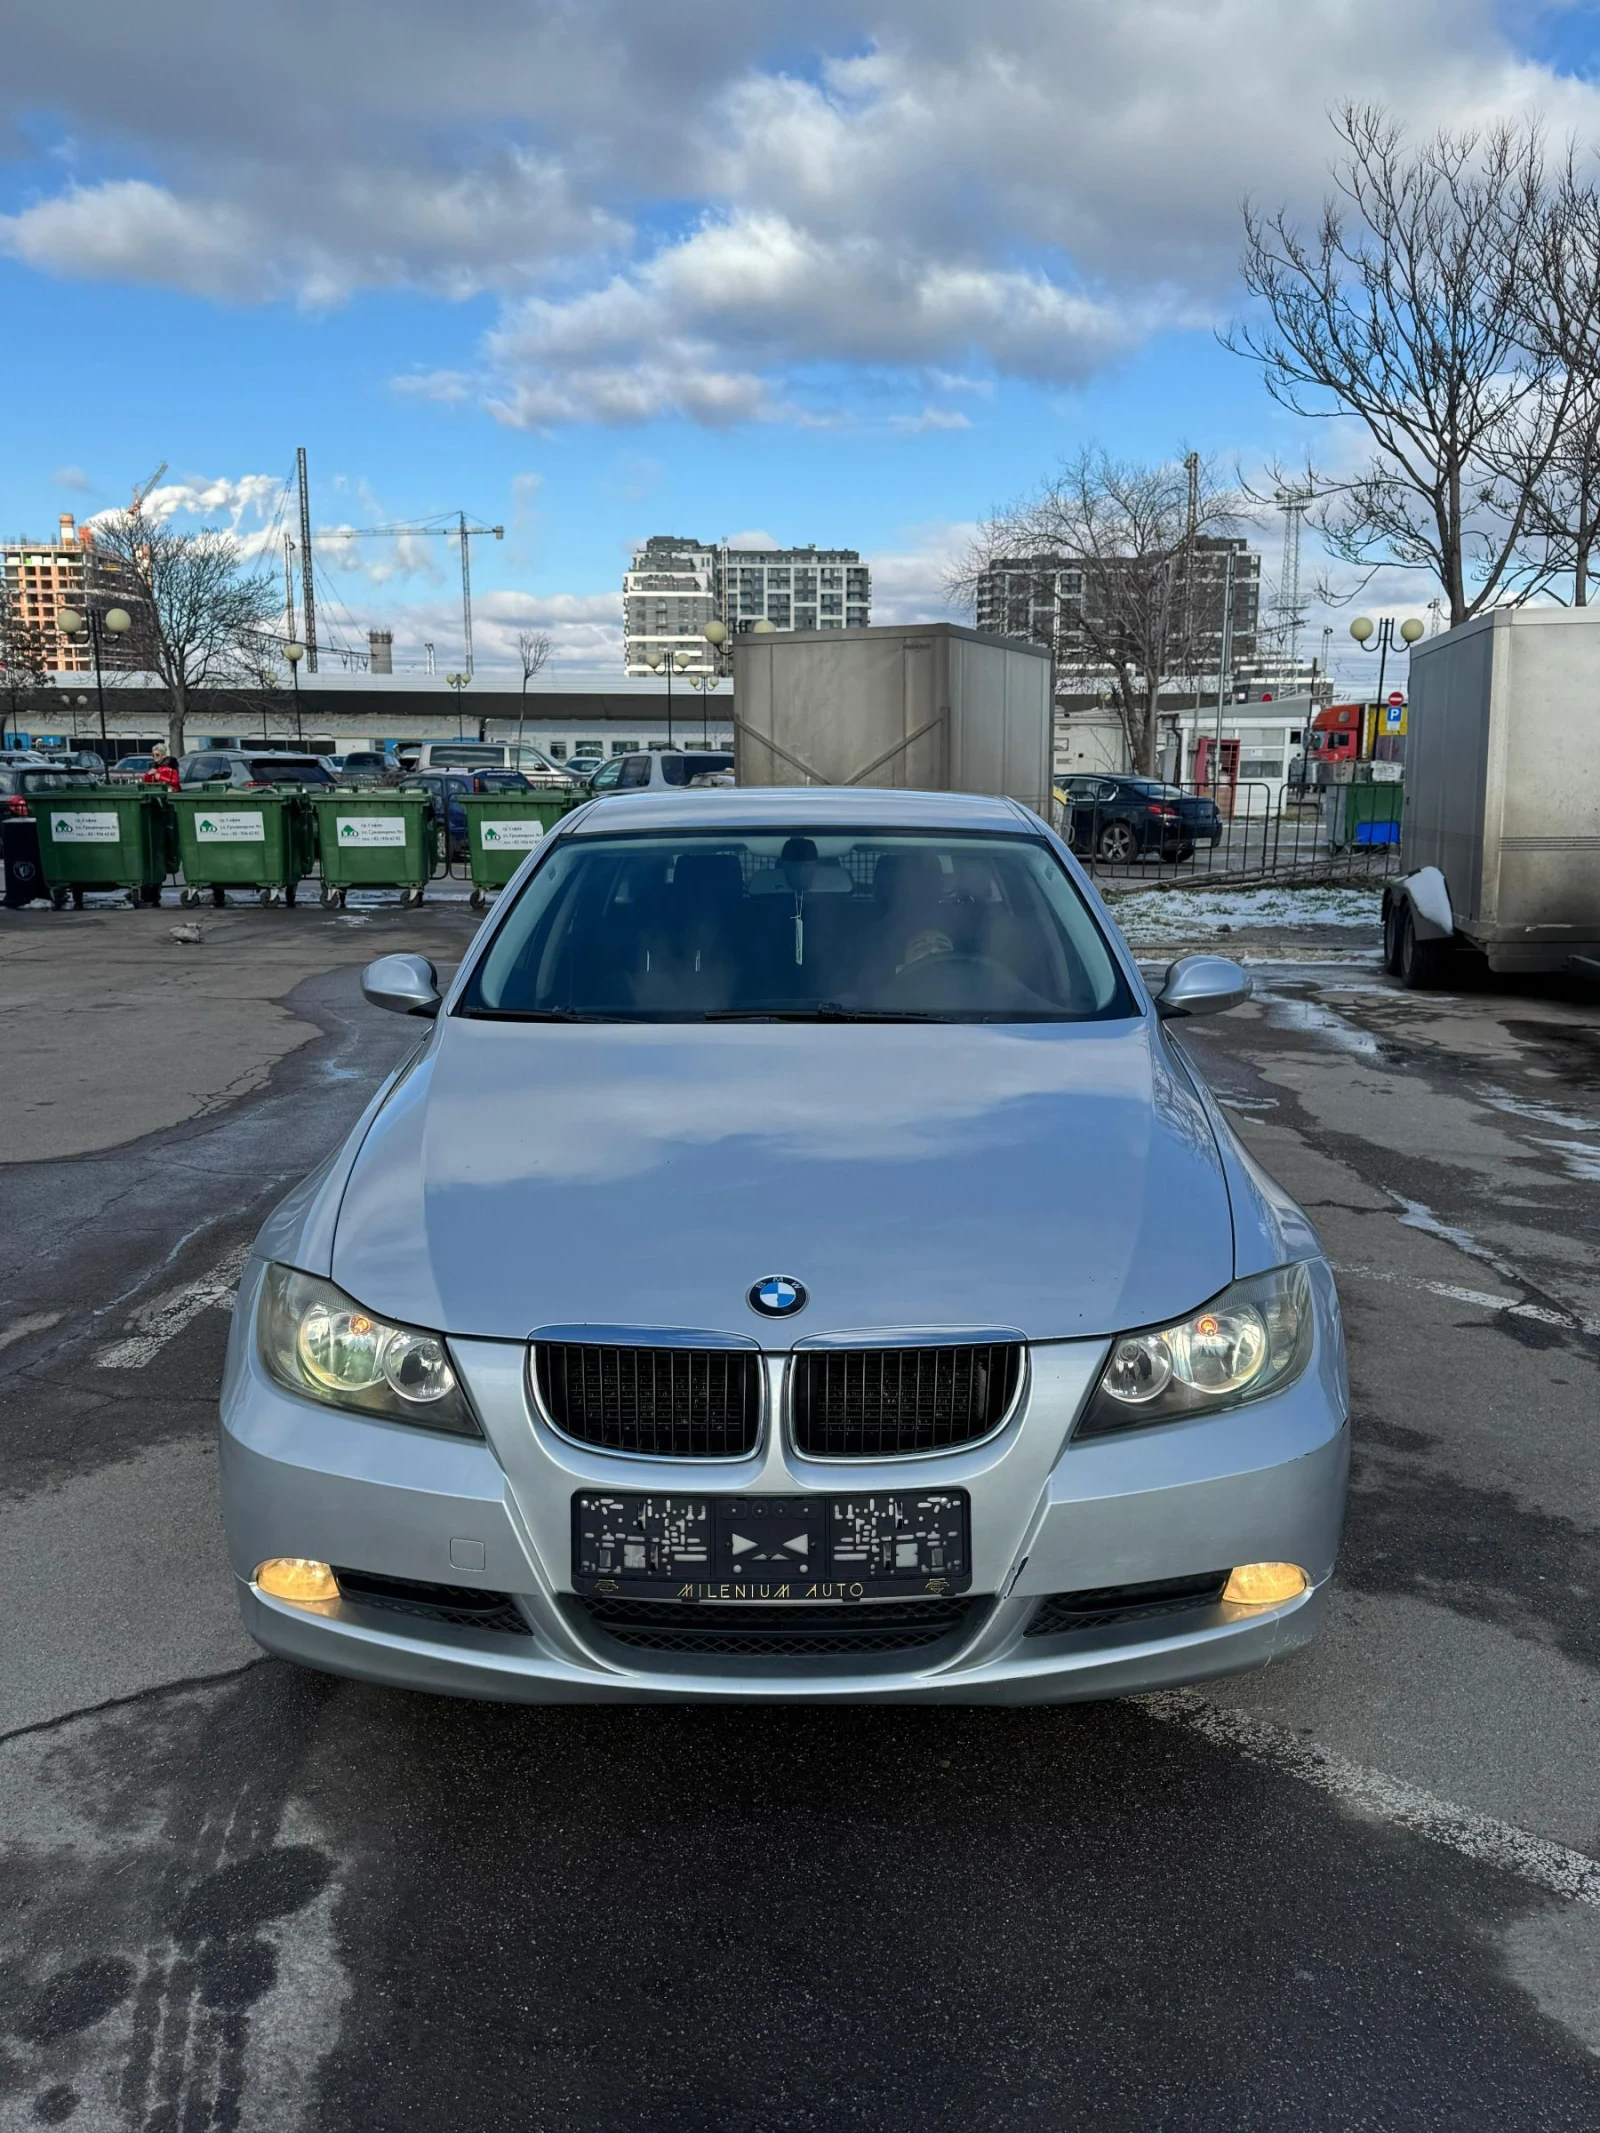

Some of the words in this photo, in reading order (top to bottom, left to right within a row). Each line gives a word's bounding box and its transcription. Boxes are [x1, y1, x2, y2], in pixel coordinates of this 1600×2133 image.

[1390, 708, 1400, 720] P
[755, 1276, 802, 1289] BMW
[677, 1583, 790, 1598] MILENIUM
[805, 1582, 864, 1597] AUTO
